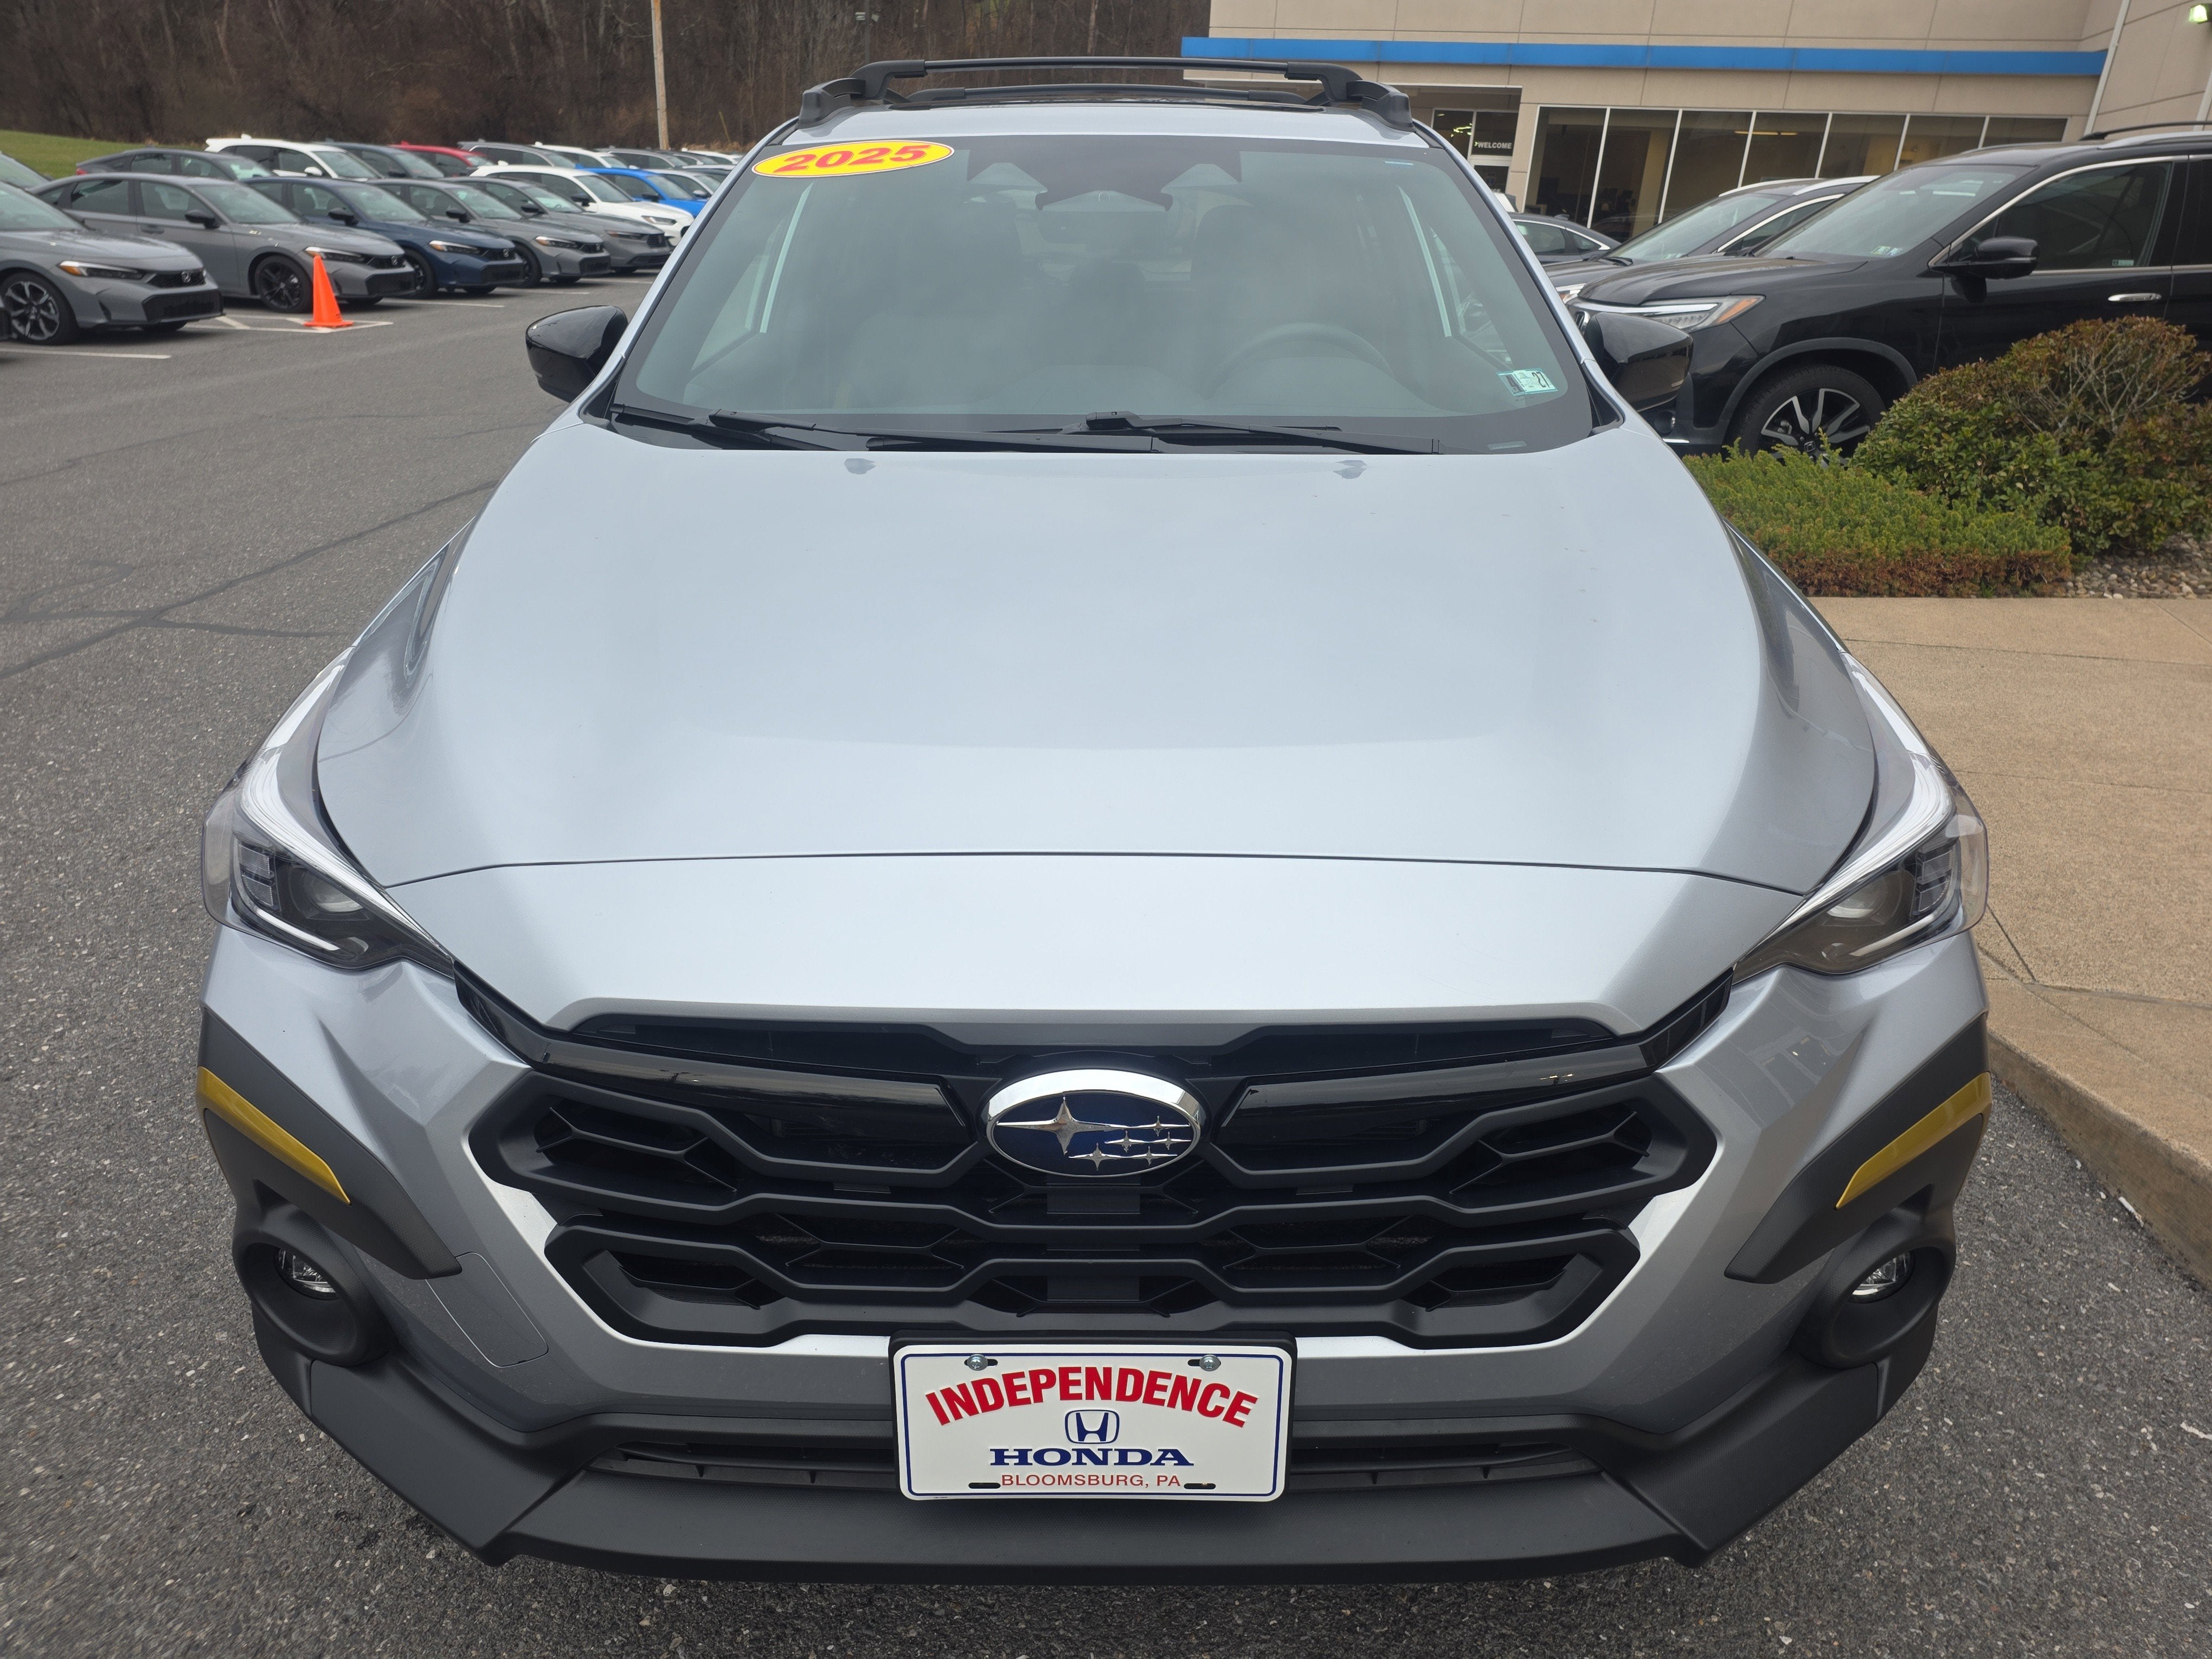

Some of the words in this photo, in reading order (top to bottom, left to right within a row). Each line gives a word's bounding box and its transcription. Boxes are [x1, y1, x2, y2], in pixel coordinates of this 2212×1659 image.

[773, 145, 931, 172] 2025
[1532, 371, 1550, 389] 27
[925, 1366, 1258, 1428] INDEPENDENCE
[989, 1448, 1194, 1466] HONDA
[1001, 1474, 1149, 1488] BLOOMSBURG,
[1156, 1475, 1181, 1487] PA
